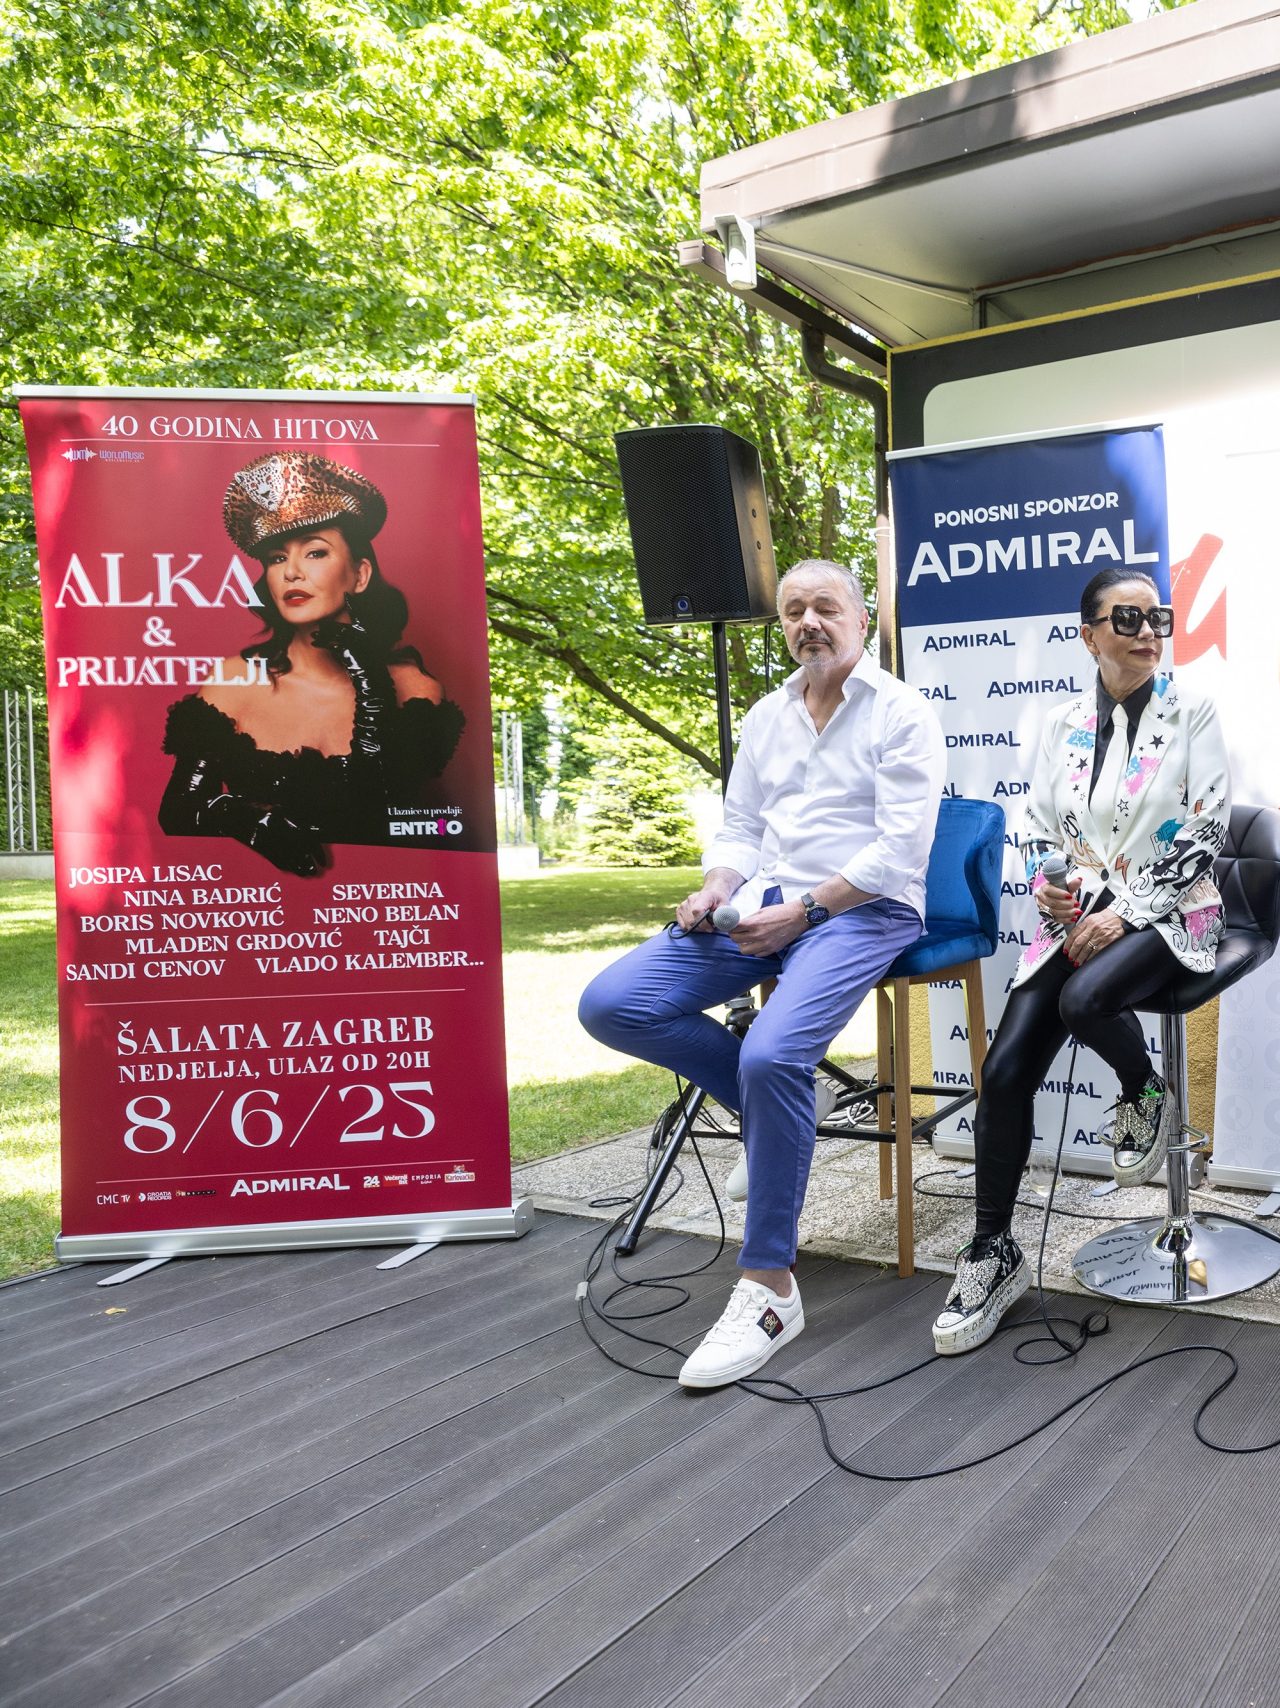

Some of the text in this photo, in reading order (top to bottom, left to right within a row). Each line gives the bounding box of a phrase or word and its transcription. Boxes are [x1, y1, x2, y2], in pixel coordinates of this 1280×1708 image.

[102, 415, 379, 440] 40 GODINA HITOVA
[934, 491, 1119, 528] PONOSNI SPONZOR
[906, 519, 1159, 587] ADMIRAL
[55, 552, 265, 609] ALKA
[142, 616, 176, 647] &
[922, 629, 1016, 653] ADMIRAL
[57, 656, 272, 688] PRIJATELJI
[986, 676, 1082, 699] ADMIRAL
[945, 730, 1021, 748] DMIRAL
[387, 806, 422, 816] Ulaznice
[431, 805, 463, 817] prodaji:
[389, 818, 463, 836] ENTRIO
[68, 864, 223, 888] JOSIPA LISAC
[123, 882, 282, 908] NINA BADRIĆ
[332, 882, 444, 901] SEVERINA
[80, 906, 285, 933] BORIS NOVKOVIĆ
[313, 903, 460, 925] NENO BELAN
[125, 929, 343, 955] MLADEN GRDOVIĆ
[374, 926, 431, 948] TAJČI
[66, 958, 226, 981] SANDI CENOV
[255, 950, 485, 974] VLADO KALEMBER...
[117, 1016, 434, 1056] ŠALATA ZAGREB
[118, 1050, 431, 1084] NEDJELJA, ULAZ OD 20H
[1040, 1080, 1102, 1099] MIRAL
[123, 1080, 436, 1154] 8/6/25
[230, 1173, 350, 1197] ADMIRAL
[363, 1175, 379, 1186] 24
[96, 1194, 130, 1204] CMC TV
